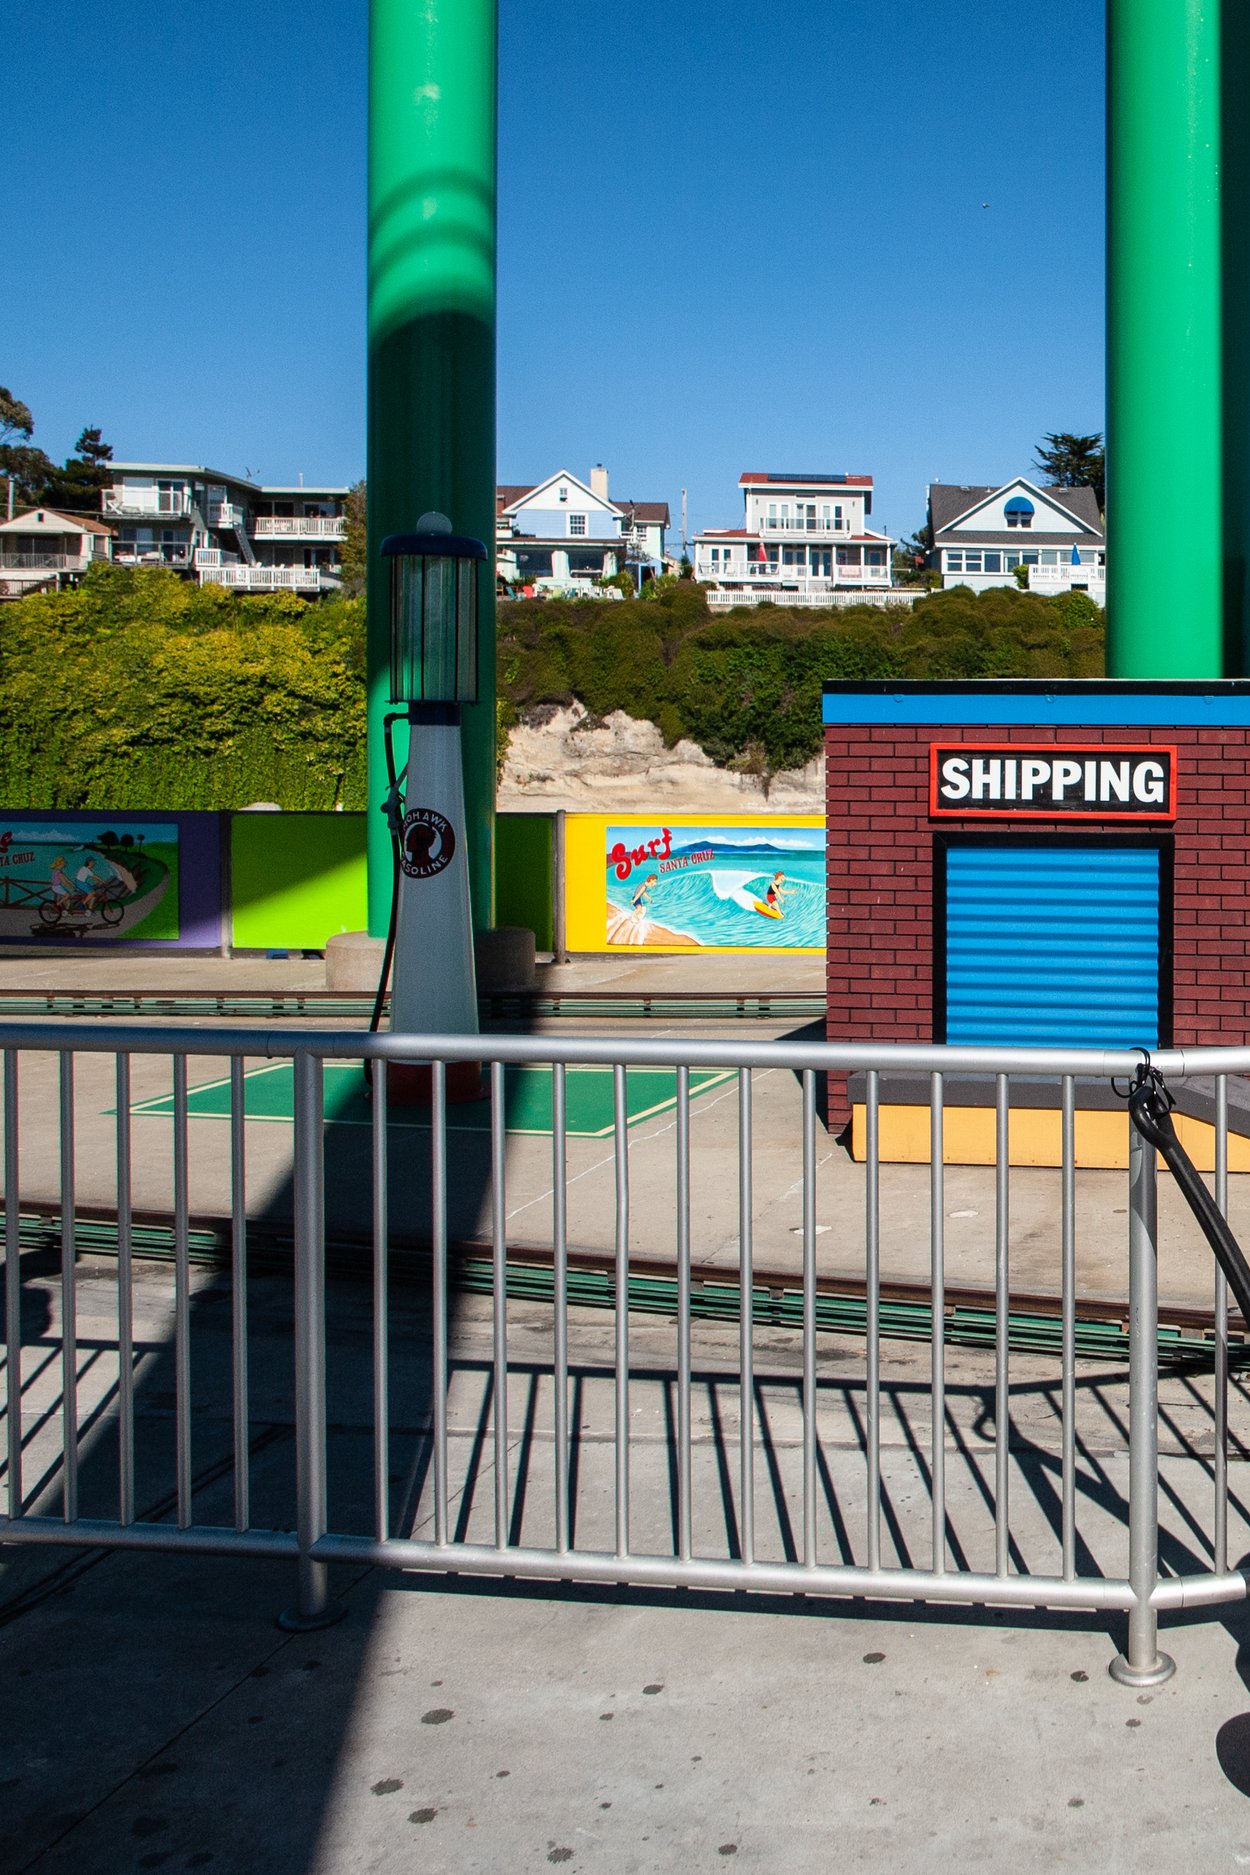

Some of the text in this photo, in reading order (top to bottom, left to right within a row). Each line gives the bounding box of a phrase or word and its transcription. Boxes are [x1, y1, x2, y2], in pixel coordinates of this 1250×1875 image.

[940, 757, 1165, 803] SHIPPING
[12, 850, 35, 865] CRUZ
[401, 852, 448, 875] ASOLINE
[611, 827, 673, 881] Surf
[659, 848, 715, 874] SANTA CRUZ
